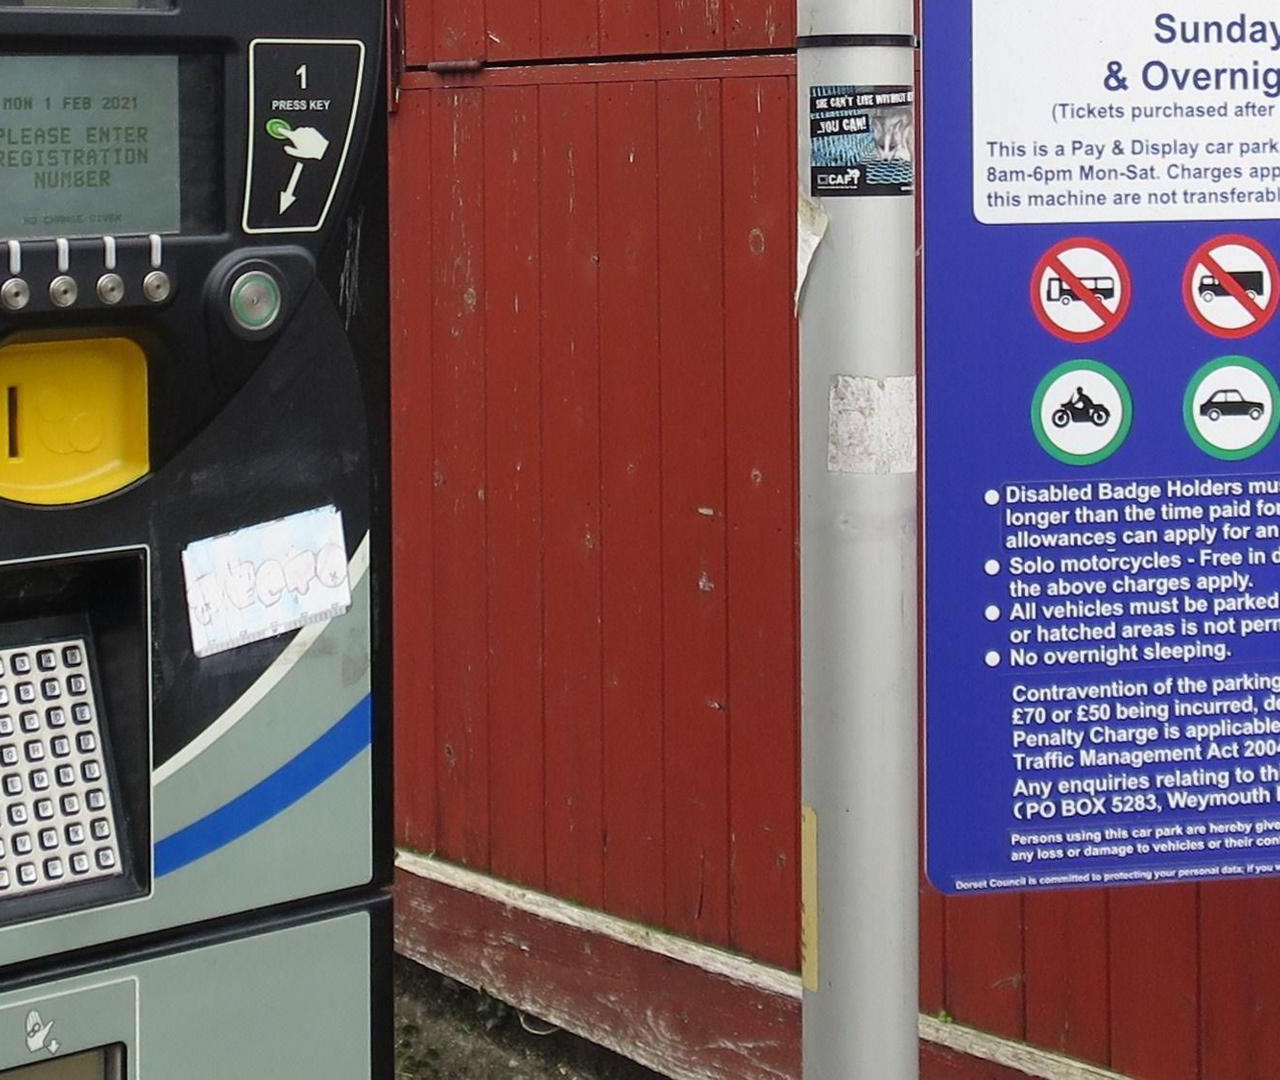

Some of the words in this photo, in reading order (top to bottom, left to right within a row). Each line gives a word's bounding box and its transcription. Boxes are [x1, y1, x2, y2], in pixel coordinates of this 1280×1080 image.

[296, 64, 306, 88] 1
[1103, 60, 1128, 91] &
[2, 96, 32, 110] MON
[45, 96, 50, 110] 1
[62, 96, 91, 110] FEB
[101, 96, 137, 110] 2021
[272, 99, 307, 110] PRESS
[309, 99, 330, 110] KEY
[1051, 102, 1124, 123] (Tickets
[1131, 101, 1228, 122] purchased
[1234, 101, 1275, 117] after
[86, 126, 148, 144] ENTER
[34, 169, 110, 189] NUMBER
[1009, 579, 1040, 597] the
[1046, 578, 1106, 595] above
[1112, 575, 1190, 593] charges
[1196, 571, 1253, 591] apply.
[1010, 648, 1038, 666] No
[1043, 644, 1138, 664] overnight
[1143, 641, 1231, 661] sleeping.
[1012, 750, 1074, 770] Traffic
[1079, 744, 1202, 766] Management
[1206, 742, 1239, 759] Act
[1061, 796, 1106, 816] BOX
[1111, 793, 1162, 812] 5283,
[1166, 786, 1270, 810] Weymouth
